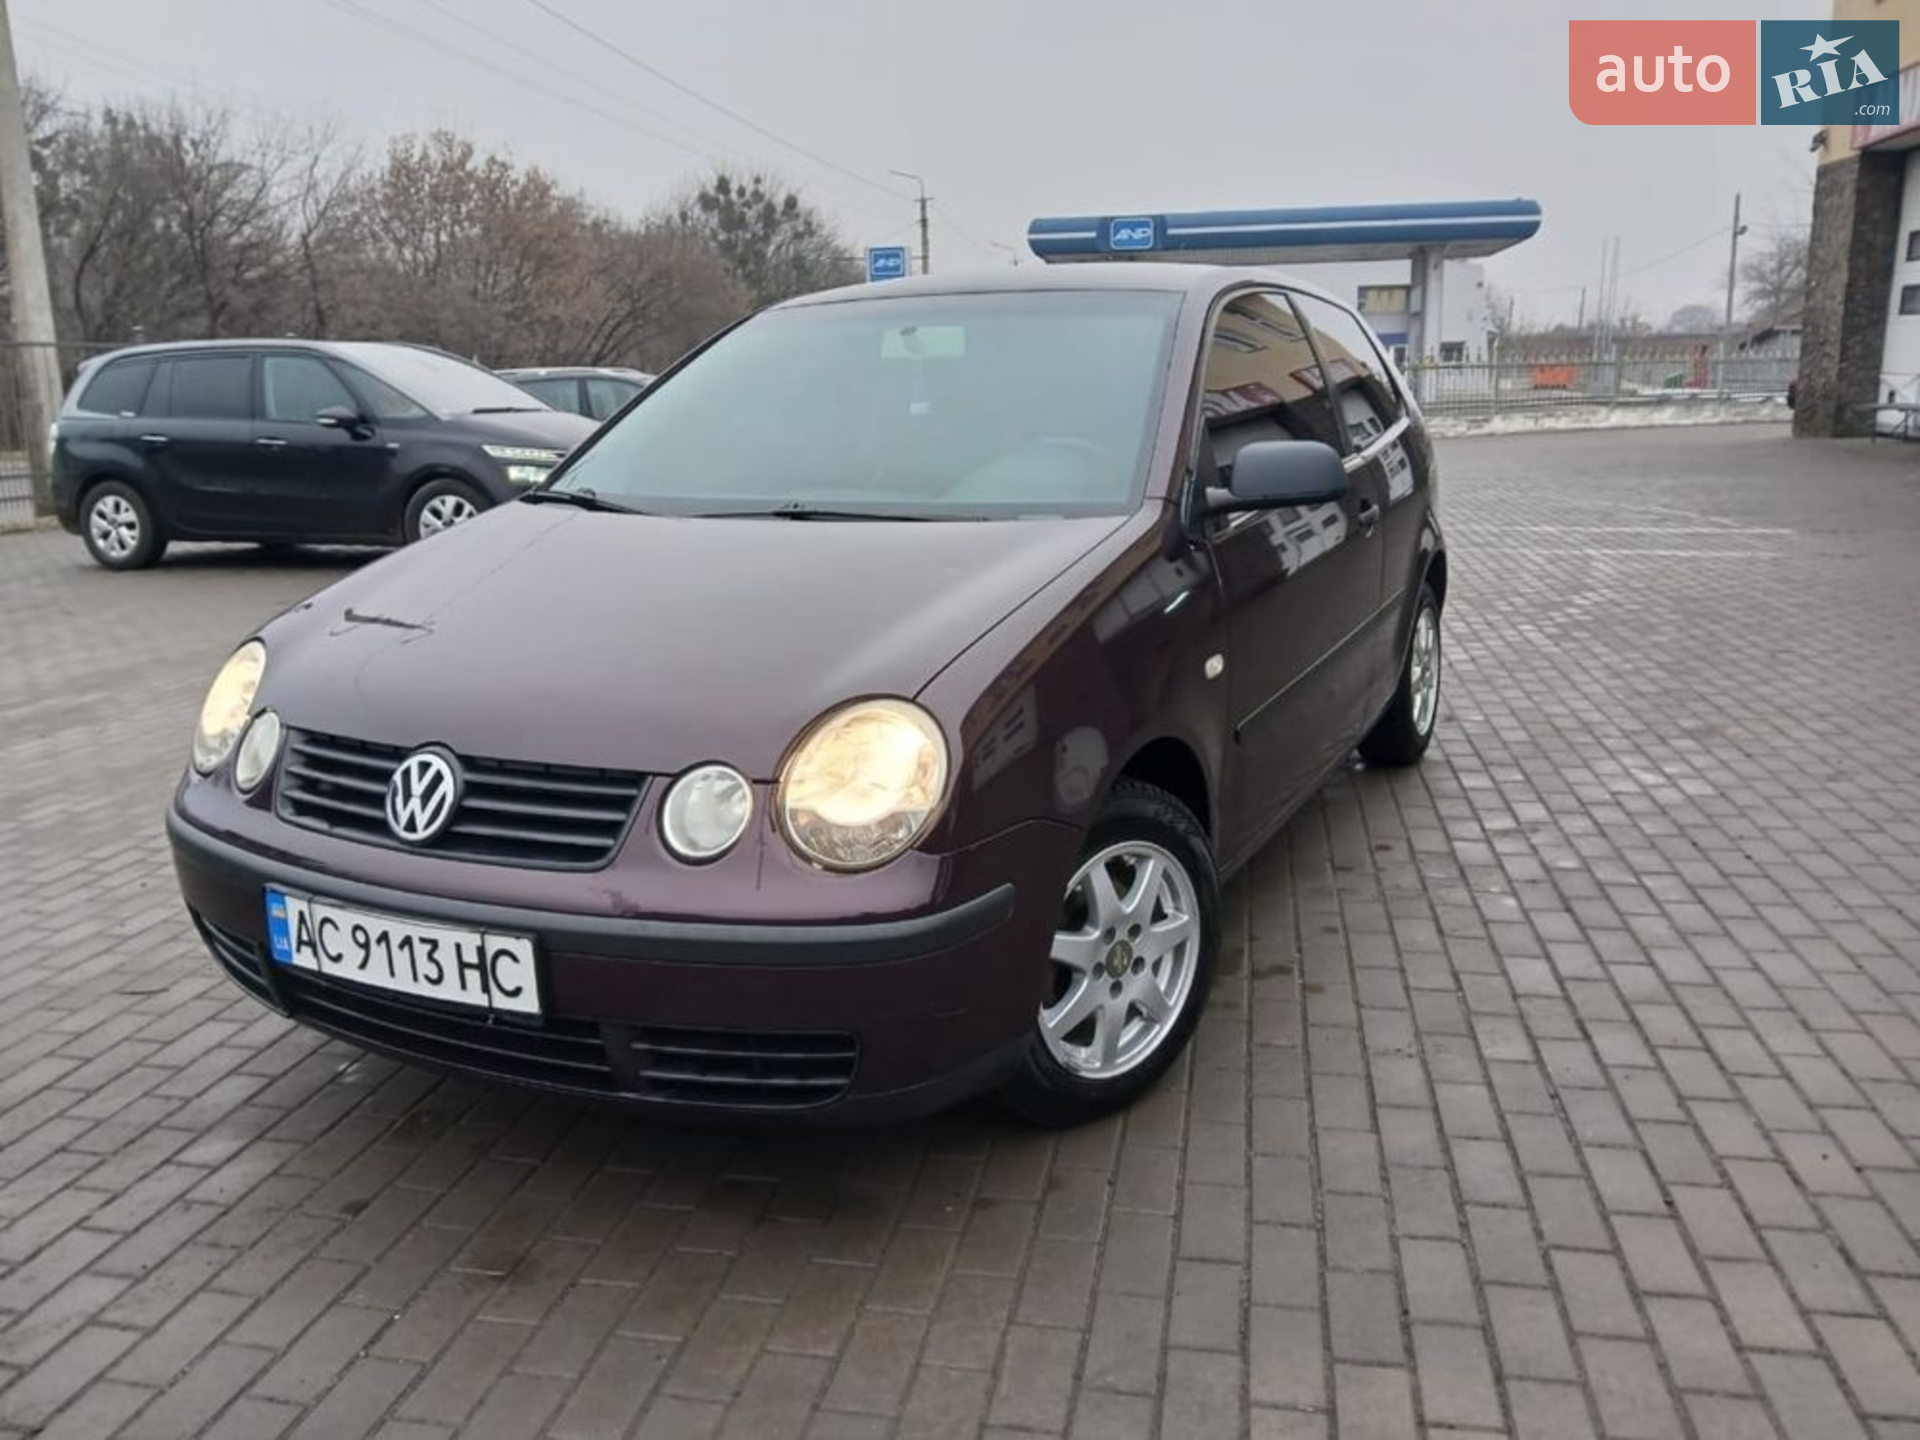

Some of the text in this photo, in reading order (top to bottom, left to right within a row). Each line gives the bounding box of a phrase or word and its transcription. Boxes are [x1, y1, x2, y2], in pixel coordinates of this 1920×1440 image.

[296, 910, 523, 998] AC 9113 HC
